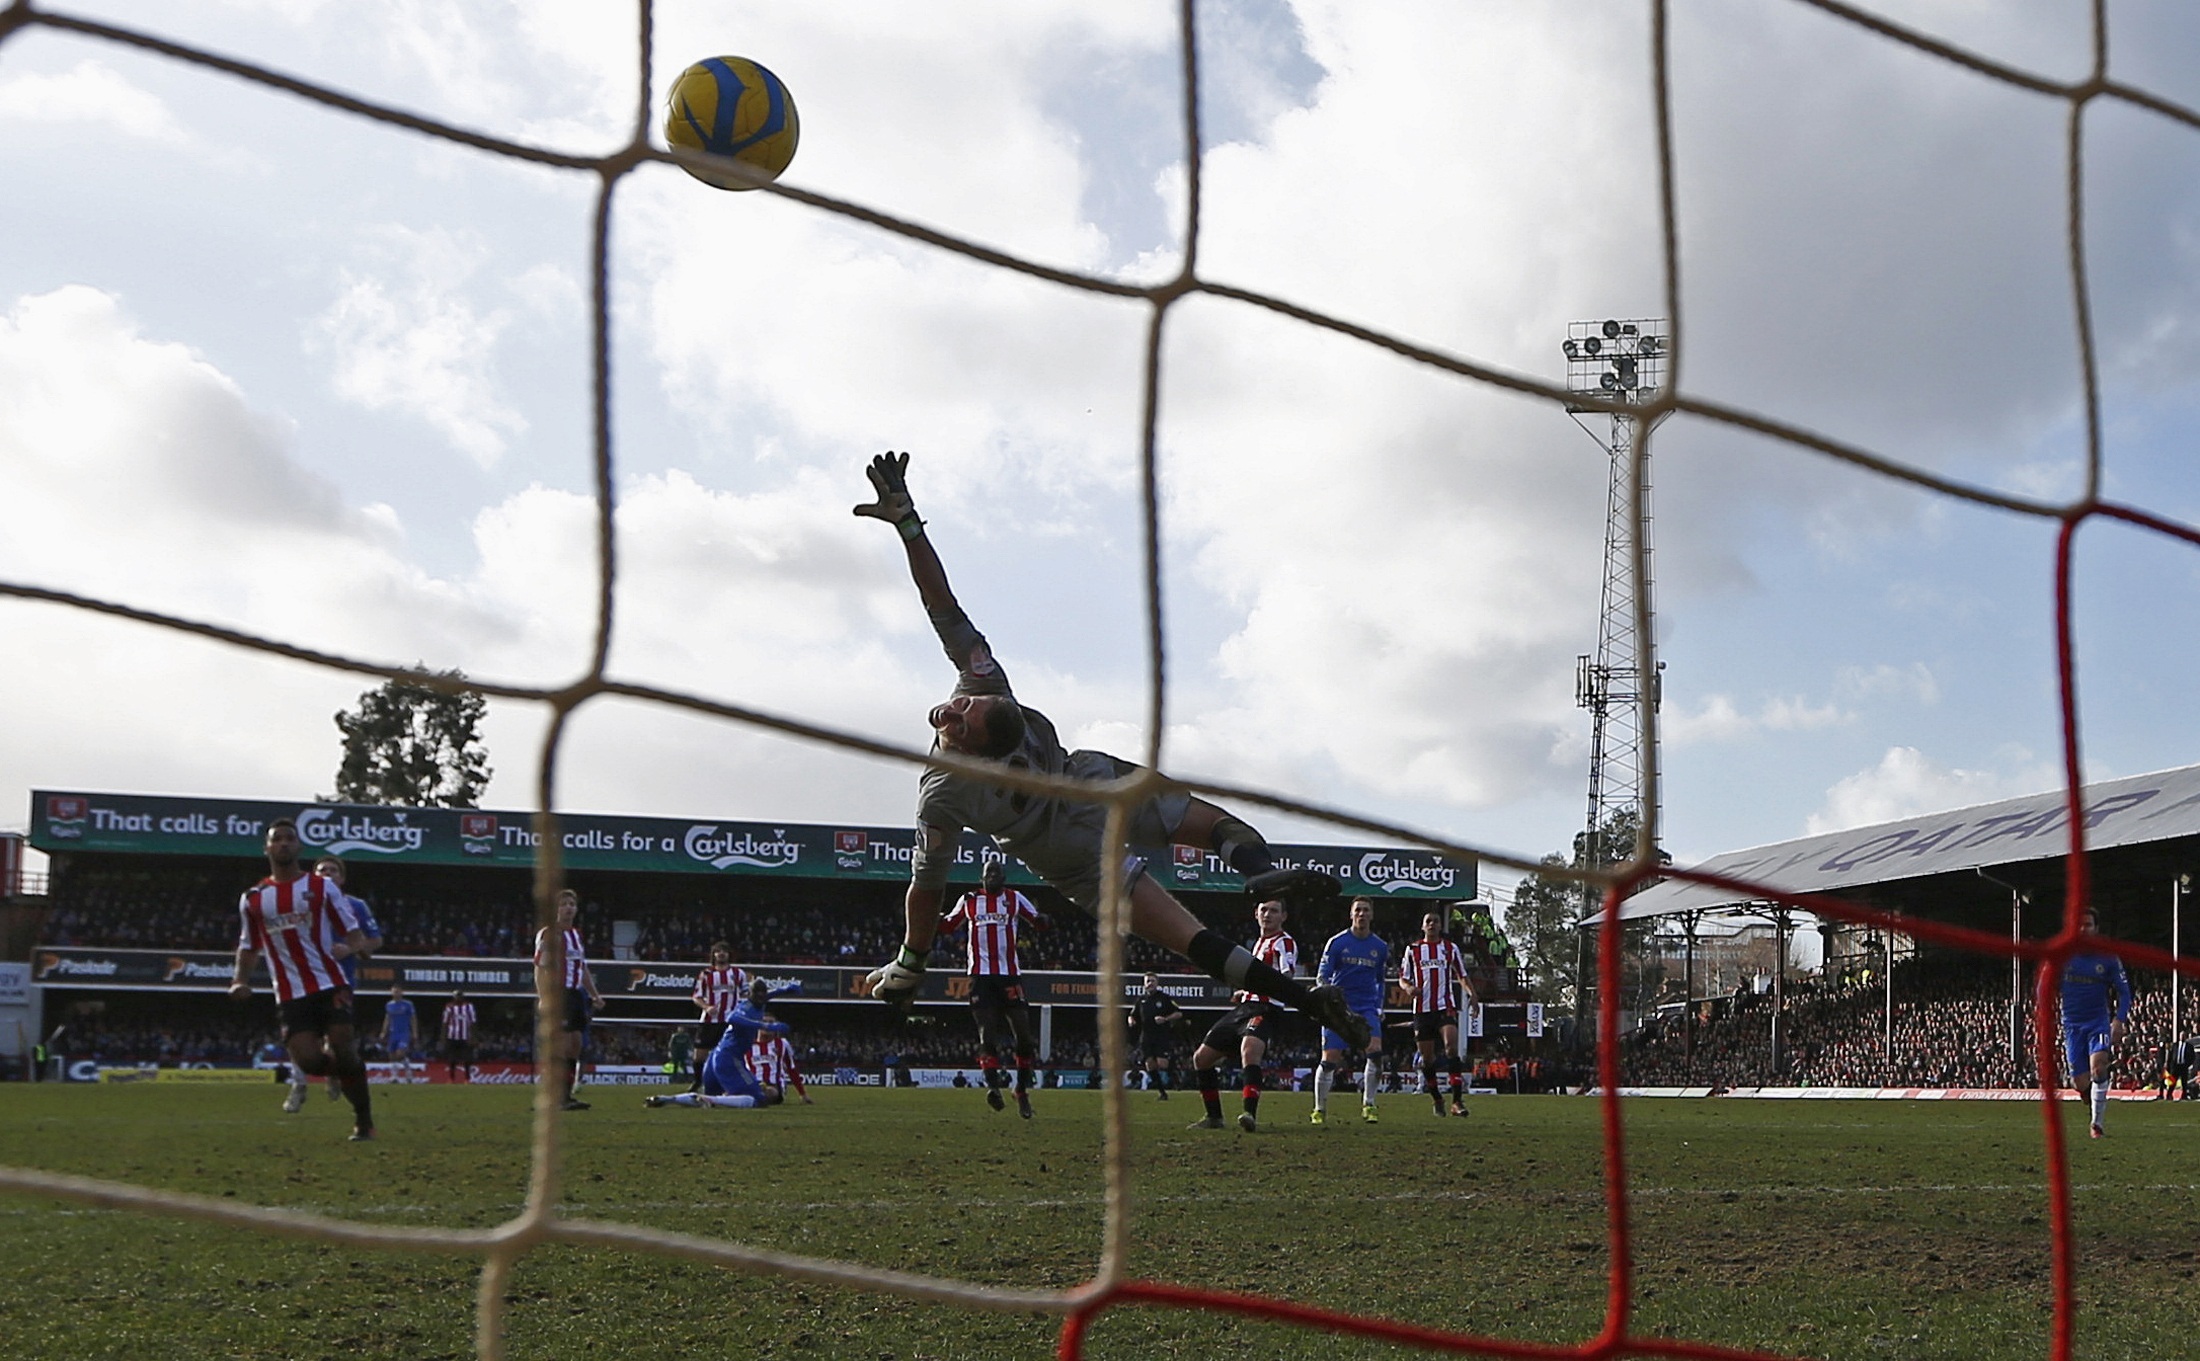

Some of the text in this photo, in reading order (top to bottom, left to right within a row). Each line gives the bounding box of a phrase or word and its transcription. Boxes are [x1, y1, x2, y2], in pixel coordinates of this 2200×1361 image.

[90, 808, 153, 832] That
[160, 814, 219, 834] calls
[226, 815, 263, 836] for
[296, 809, 422, 855] Carlsberg
[499, 825, 799, 870] Tha calls for a Carlsberg
[1817, 789, 2161, 872] QATAR
[1340, 864, 1351, 878] a
[1359, 853, 1454, 893] Carlsberg
[404, 969, 448, 982] TIMBER
[450, 971, 464, 982] TO
[467, 971, 510, 983] TIMBER
[646, 974, 694, 988] Paslode
[626, 1075, 669, 1085] DECKER
